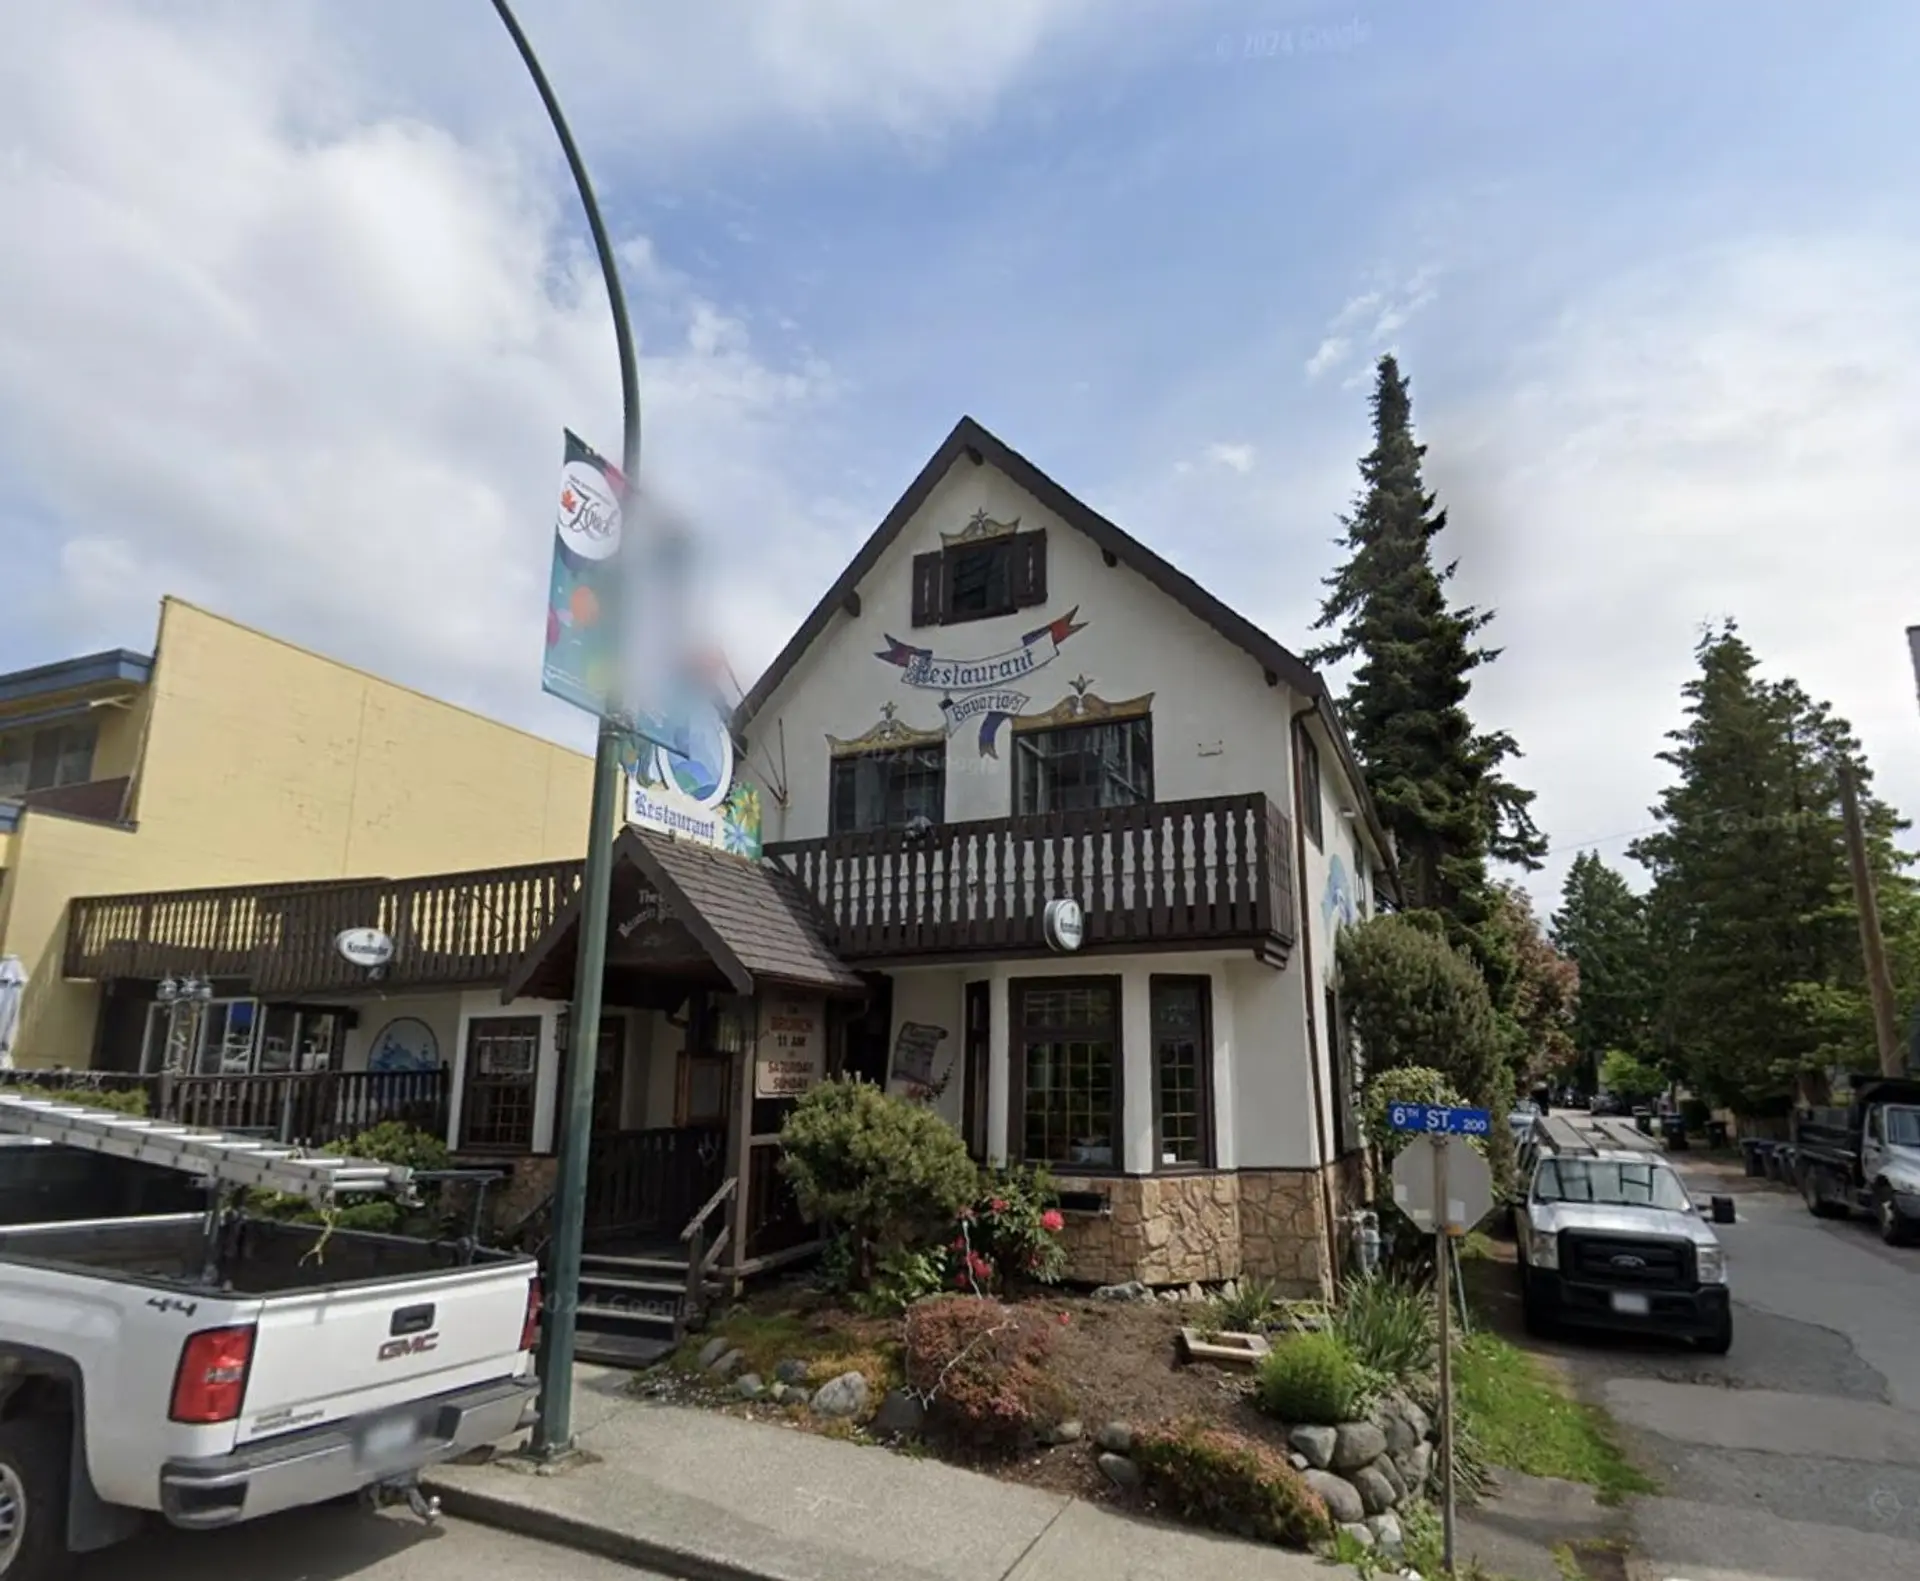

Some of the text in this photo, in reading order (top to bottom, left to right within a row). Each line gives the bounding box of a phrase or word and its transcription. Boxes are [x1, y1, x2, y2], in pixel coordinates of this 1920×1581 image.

[910, 648, 1036, 686] Restaurant
[635, 791, 715, 840] Restaurant
[1392, 1107, 1488, 1132] 6TH ST. 200
[377, 1332, 440, 1361] GMC
